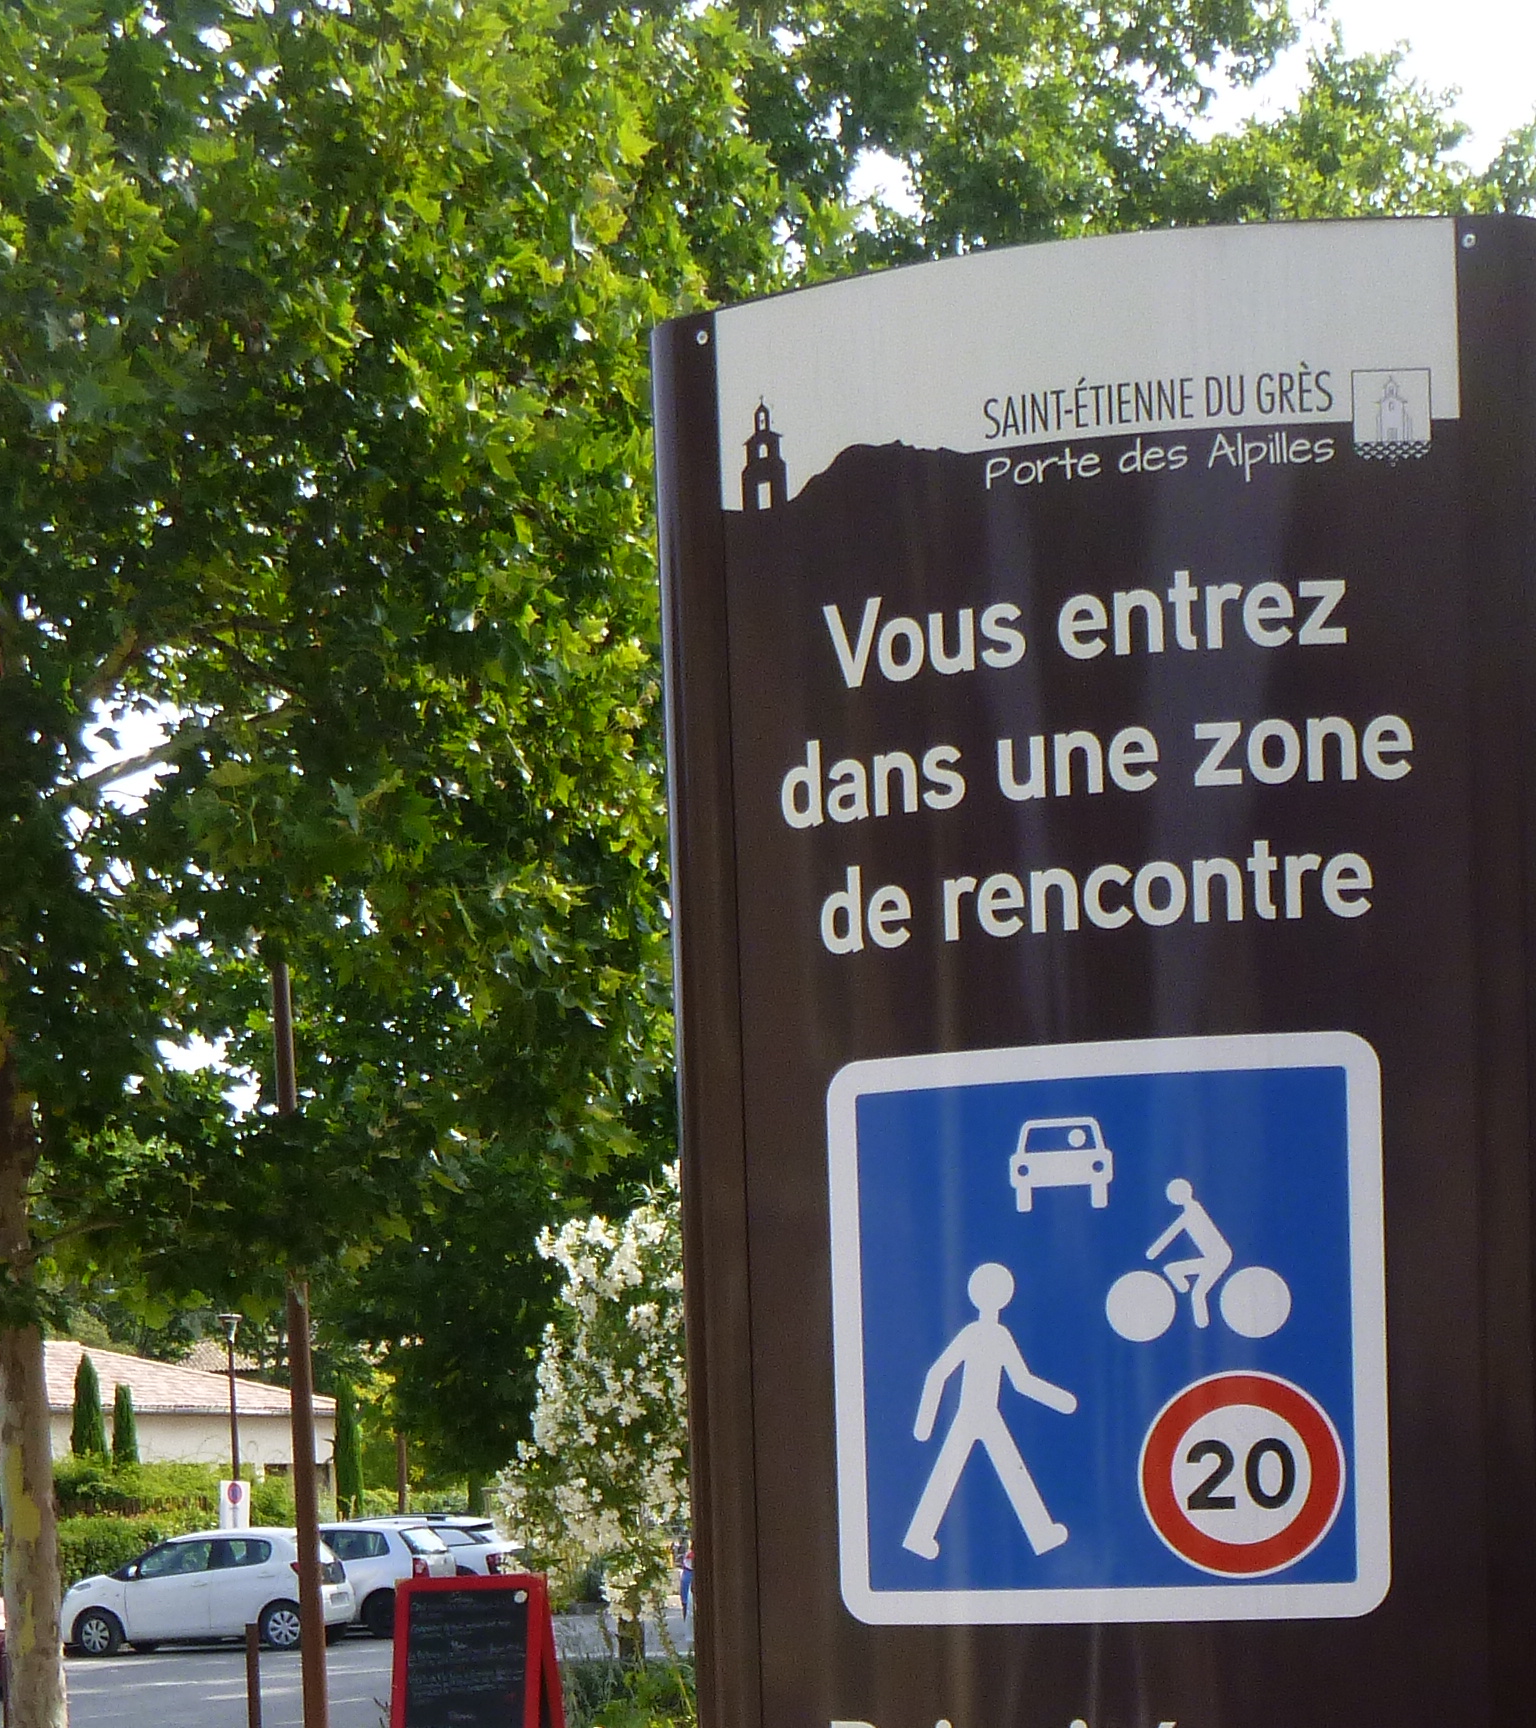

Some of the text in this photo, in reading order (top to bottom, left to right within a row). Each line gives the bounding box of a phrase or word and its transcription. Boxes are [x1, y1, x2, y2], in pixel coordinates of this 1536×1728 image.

[984, 361, 1333, 439] SAINT-ÉTIENNE DU GRÈS
[985, 432, 1335, 489] Porte des Alpilles
[823, 570, 1347, 688] Vous entrez
[781, 714, 1414, 830] dans une zone
[821, 840, 1374, 955] de rencontre
[1185, 1437, 1296, 1511] 20
